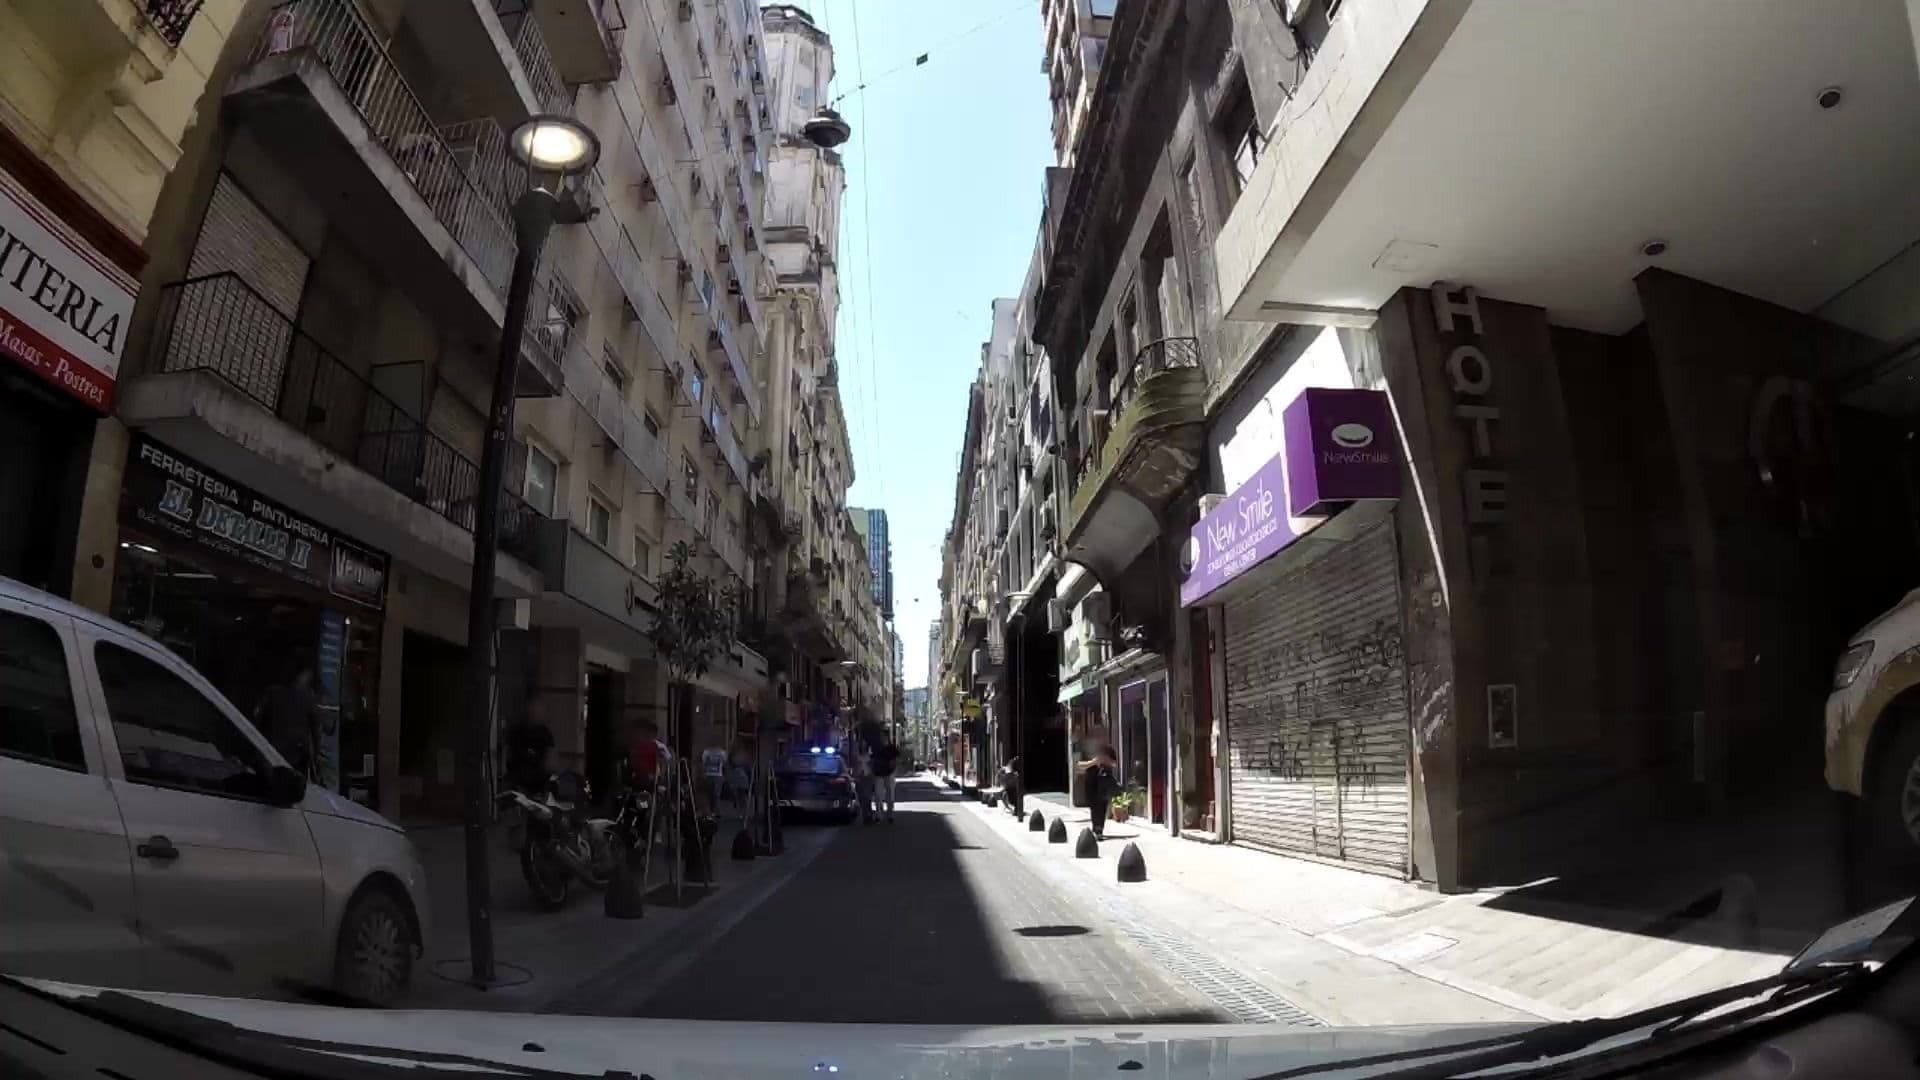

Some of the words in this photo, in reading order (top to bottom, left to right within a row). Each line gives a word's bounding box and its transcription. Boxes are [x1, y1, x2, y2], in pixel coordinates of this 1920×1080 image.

[0, 225, 120, 355] ITERIA
[53, 356, 105, 403] Postres
[140, 442, 239, 505] FERRETERIA
[251, 499, 329, 547] PINTURERIA
[1207, 516, 1236, 560] New
[1239, 477, 1273, 536] Smile
